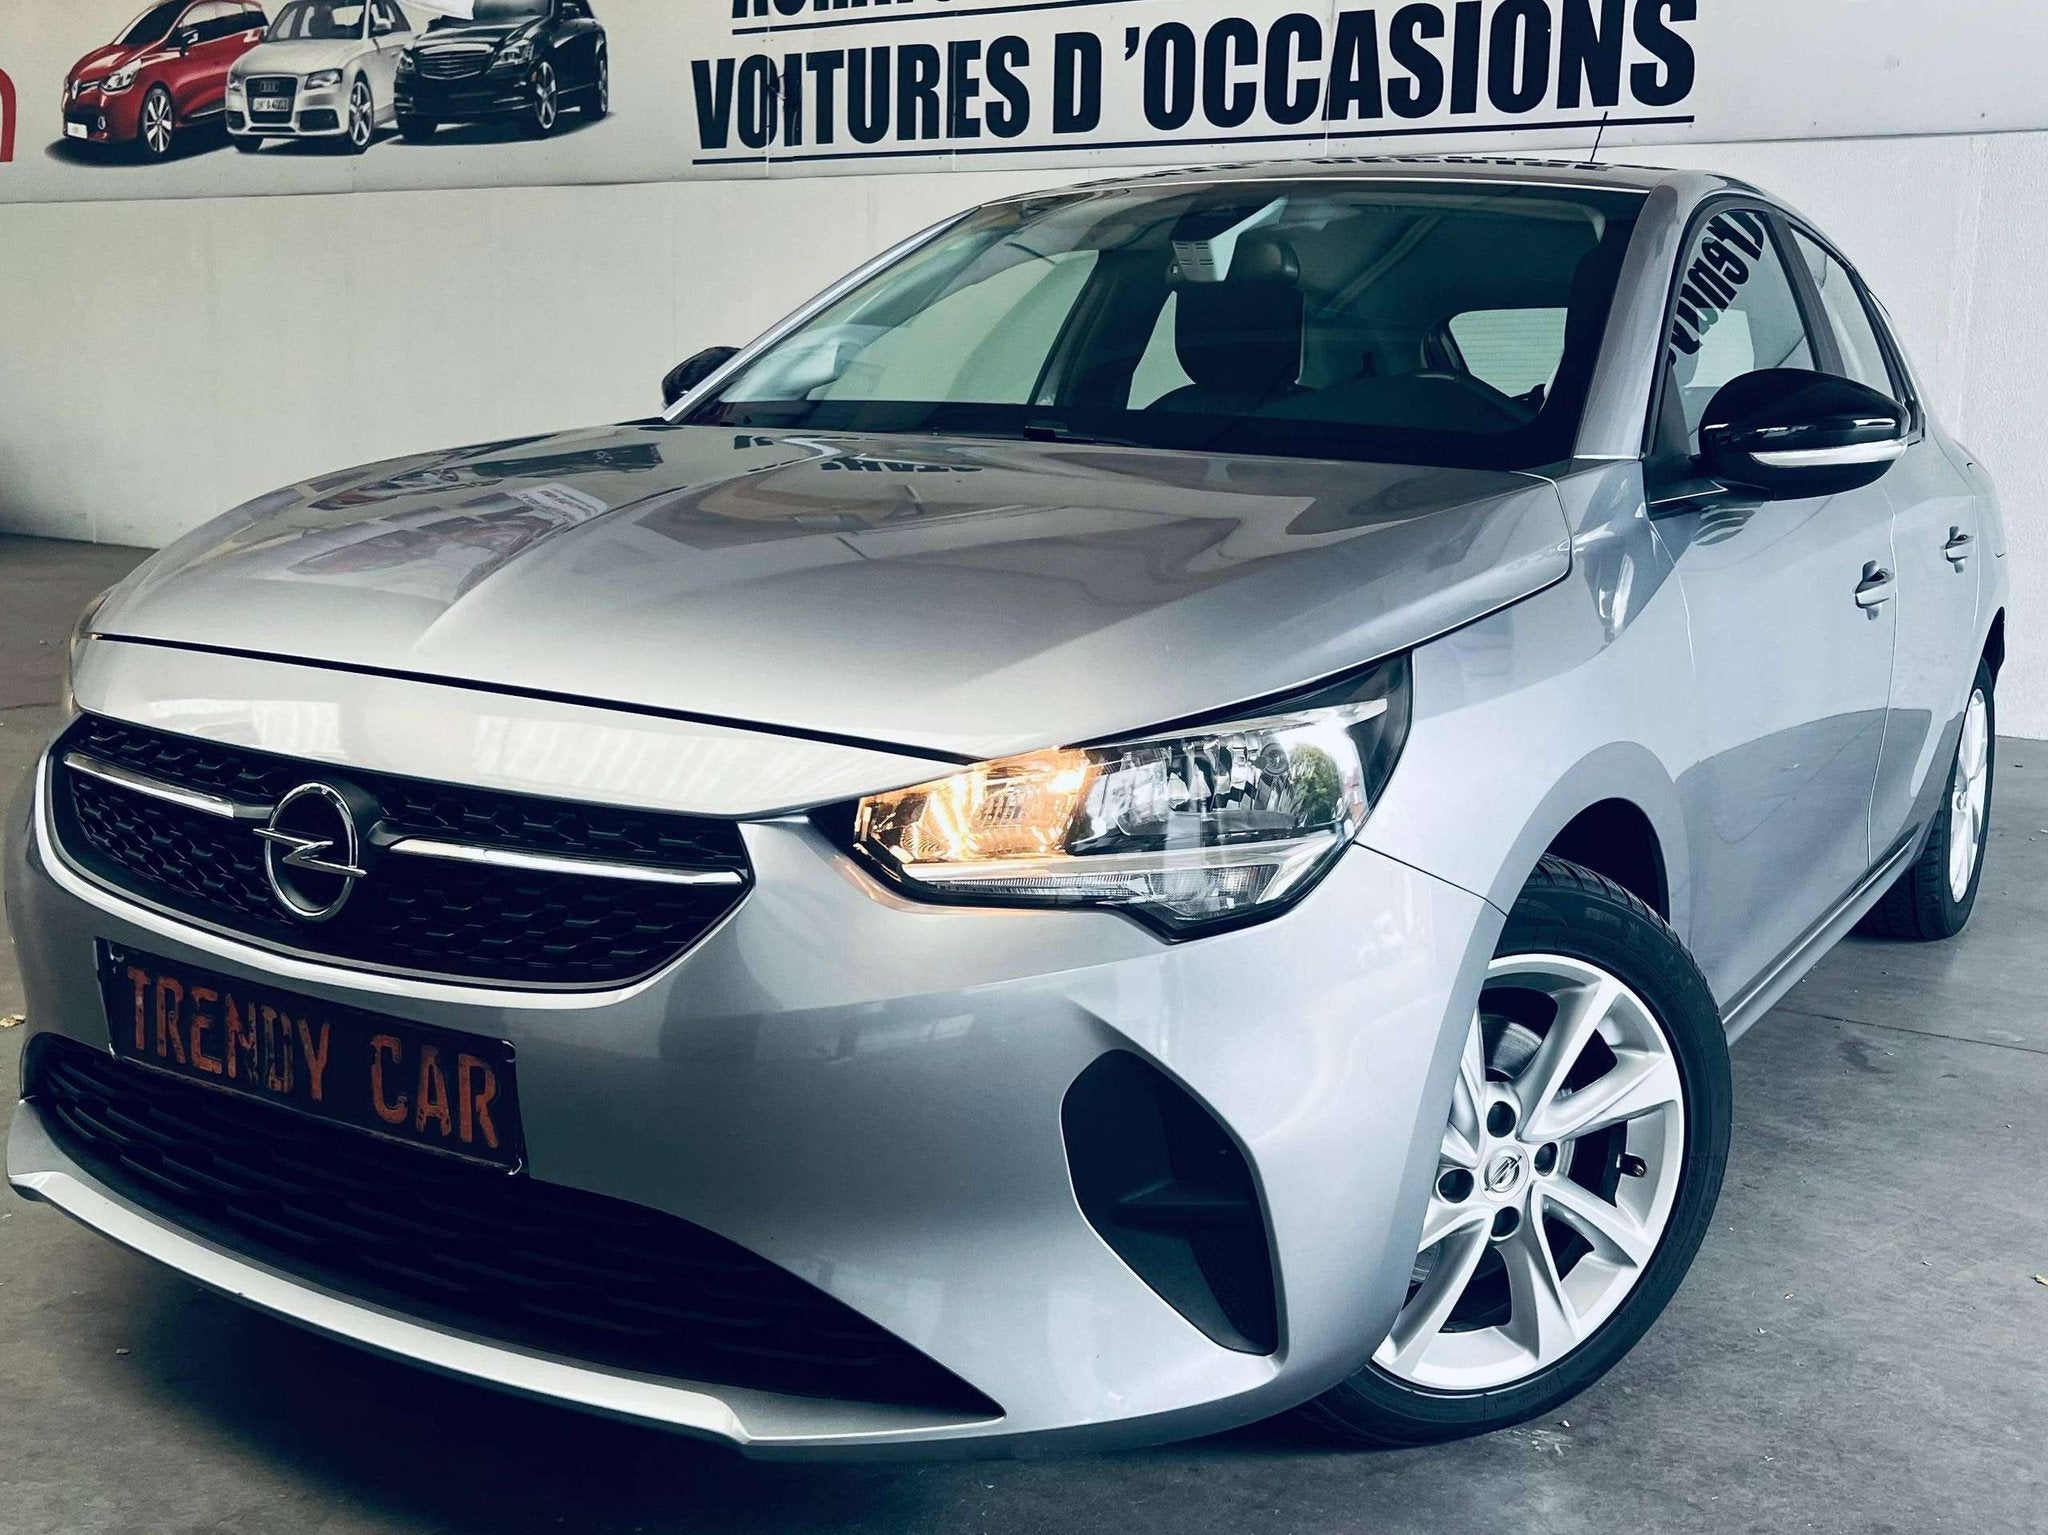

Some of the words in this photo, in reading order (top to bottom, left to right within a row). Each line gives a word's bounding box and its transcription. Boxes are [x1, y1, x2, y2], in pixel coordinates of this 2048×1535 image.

[691, 35, 1031, 149] VOITURES
[1052, 32, 1101, 134] D
[127, 966, 331, 1101] TRENDY
[370, 1033, 499, 1149] CAR
